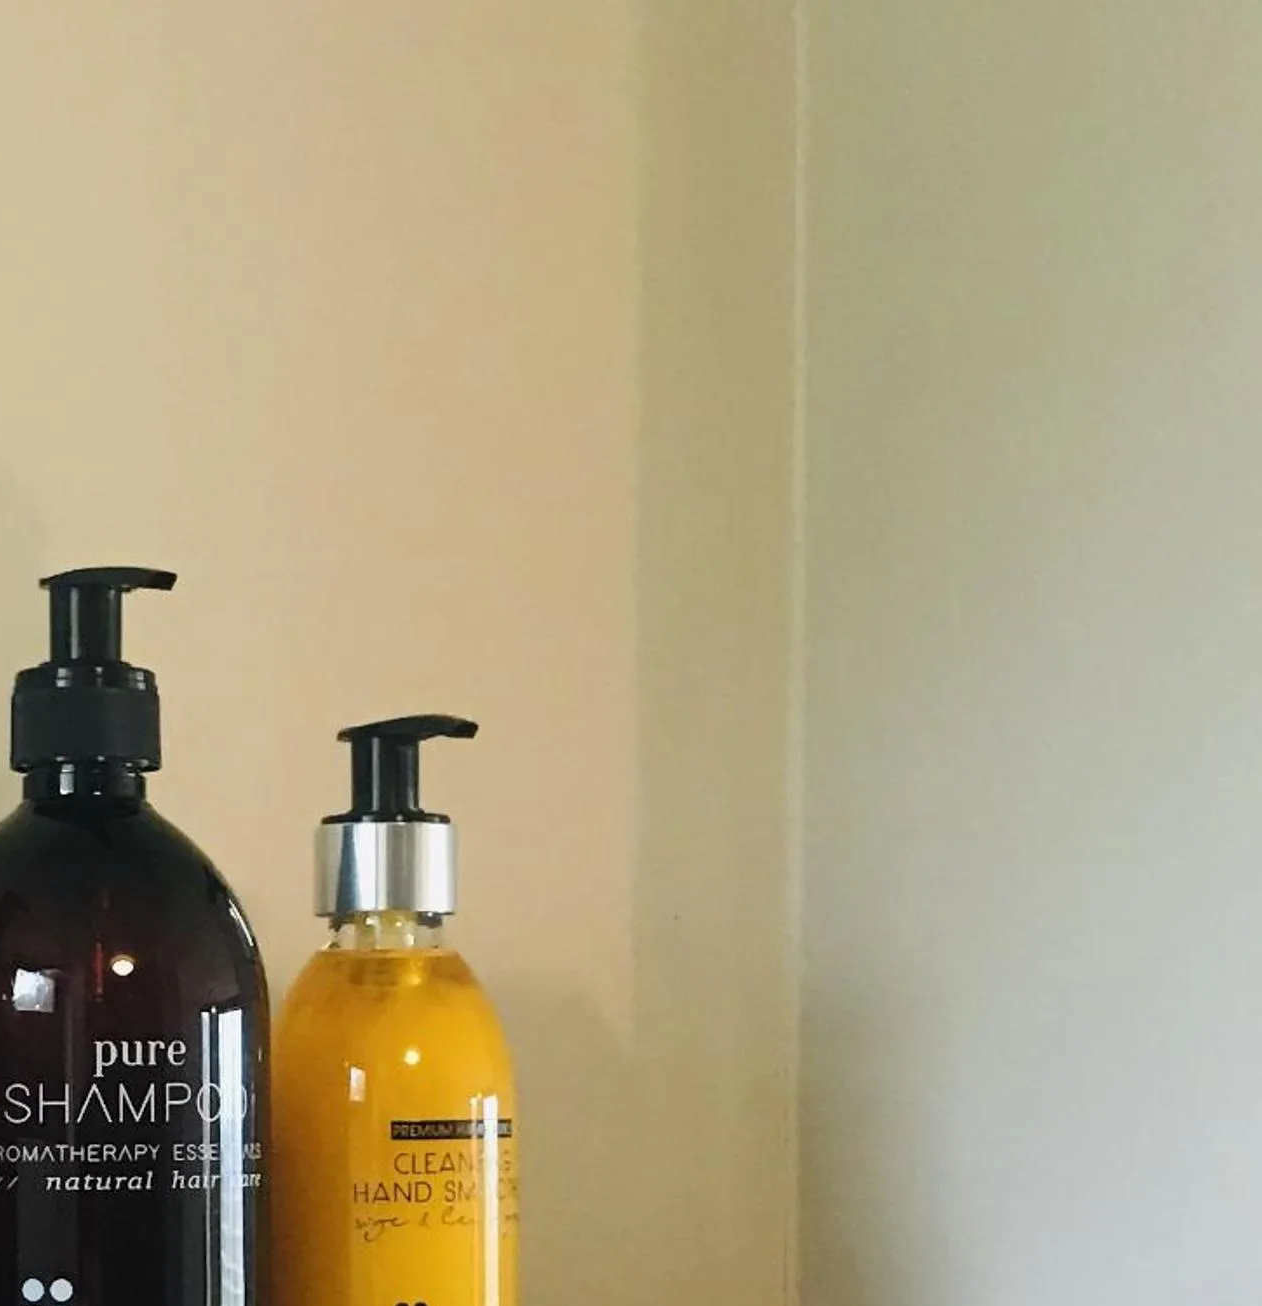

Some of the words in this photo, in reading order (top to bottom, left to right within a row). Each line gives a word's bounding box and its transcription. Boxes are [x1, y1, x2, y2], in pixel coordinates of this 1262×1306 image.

[92, 1039, 187, 1079] pure
[3, 1082, 248, 1124] SHAMPO
[45, 1170, 154, 1191] natural
[170, 1169, 223, 1189] hair
[353, 1181, 433, 1204] HAND
